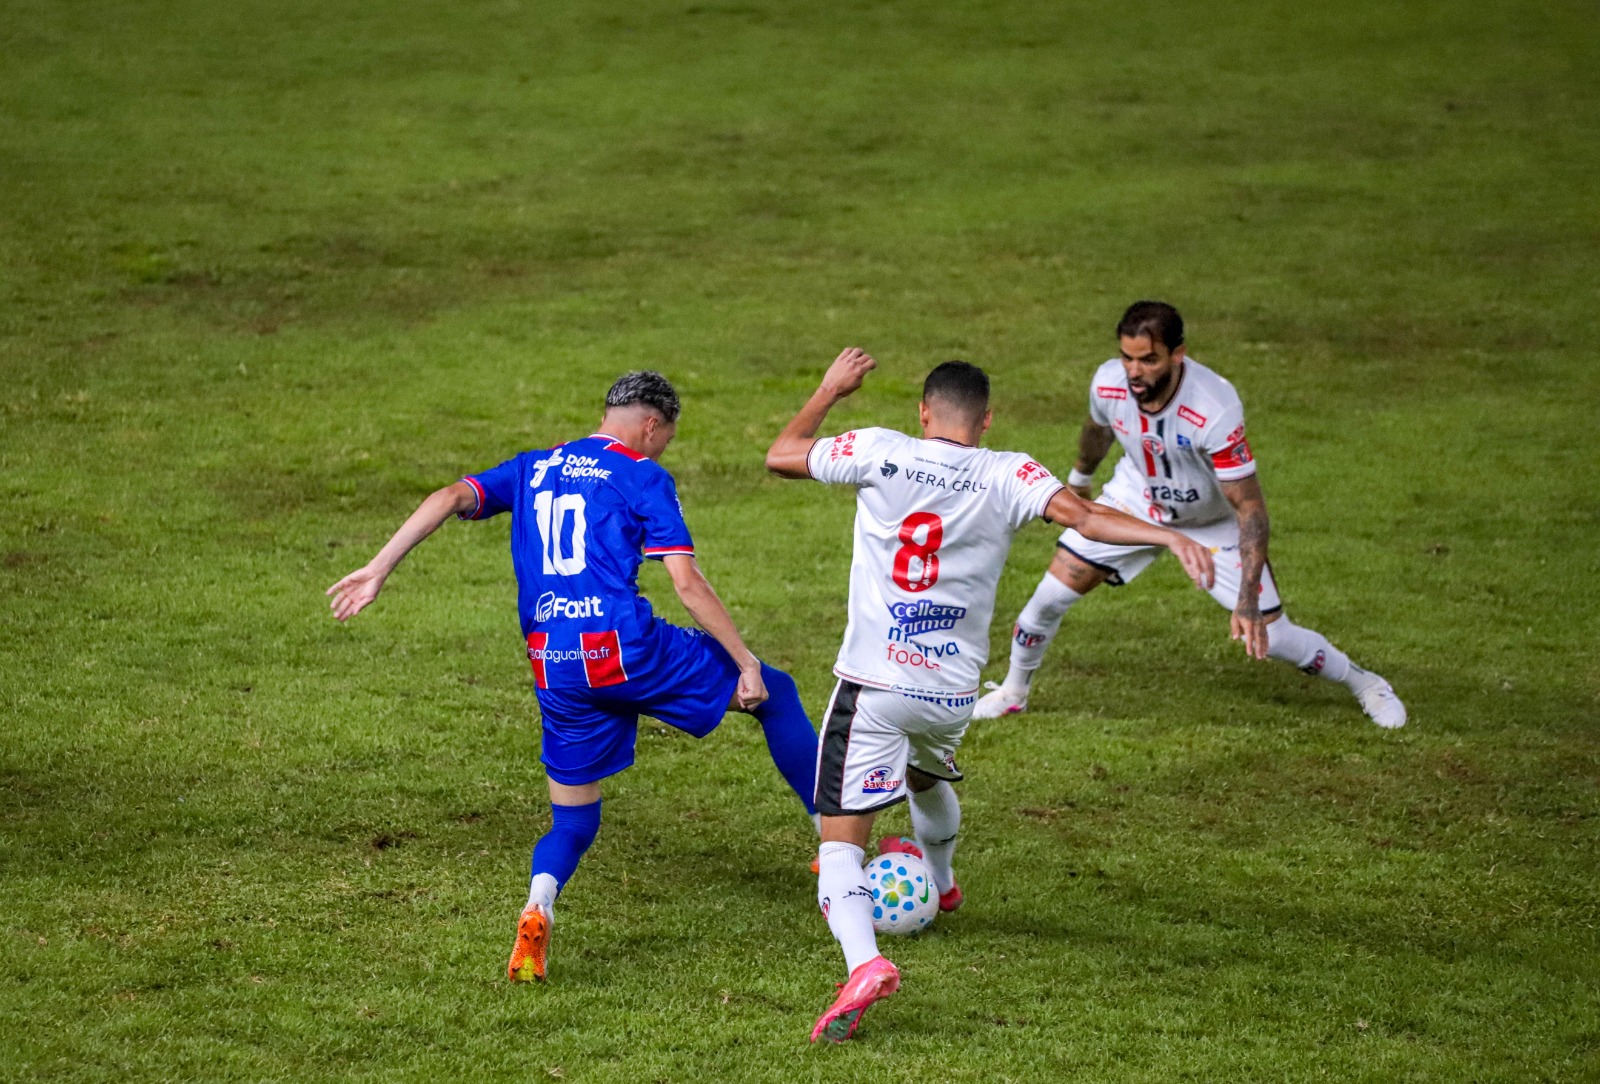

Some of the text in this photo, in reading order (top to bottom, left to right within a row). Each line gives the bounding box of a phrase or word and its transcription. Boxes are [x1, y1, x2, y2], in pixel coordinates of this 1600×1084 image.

[566, 454, 599, 467] DOM
[562, 464, 612, 480] ORIONE
[906, 468, 946, 490] VERA
[533, 490, 587, 577] 10
[892, 511, 943, 593] 8
[553, 596, 604, 619] Facit
[893, 602, 963, 618] cellera
[863, 780, 902, 790] Savegn
